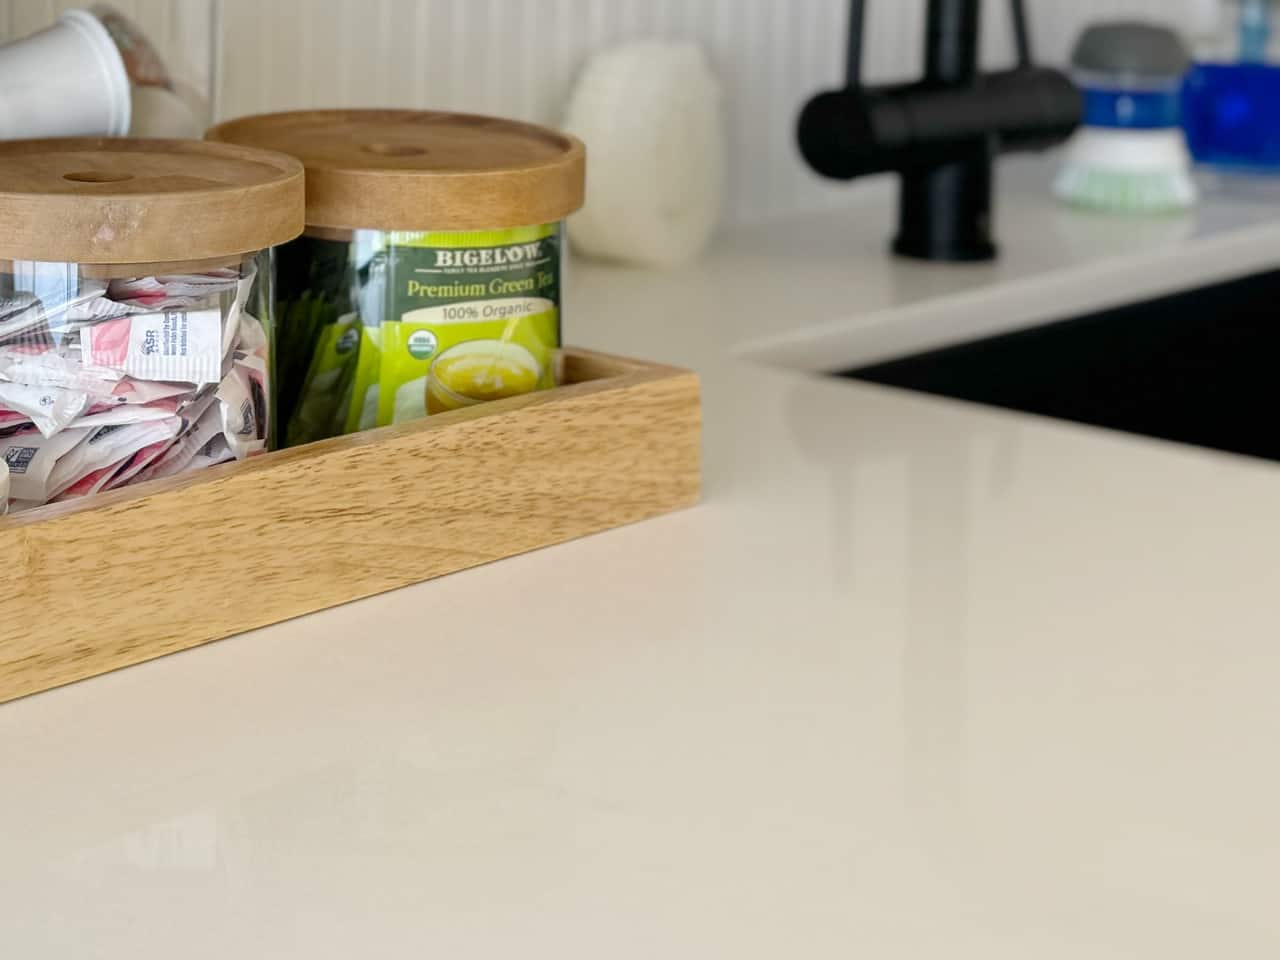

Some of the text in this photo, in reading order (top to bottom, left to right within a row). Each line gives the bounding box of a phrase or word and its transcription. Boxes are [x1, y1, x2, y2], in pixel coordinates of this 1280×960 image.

[434, 243, 541, 266] BIGELOW
[407, 280, 486, 297] Premium
[488, 276, 535, 295] Green
[442, 301, 533, 320] 100% Organic
